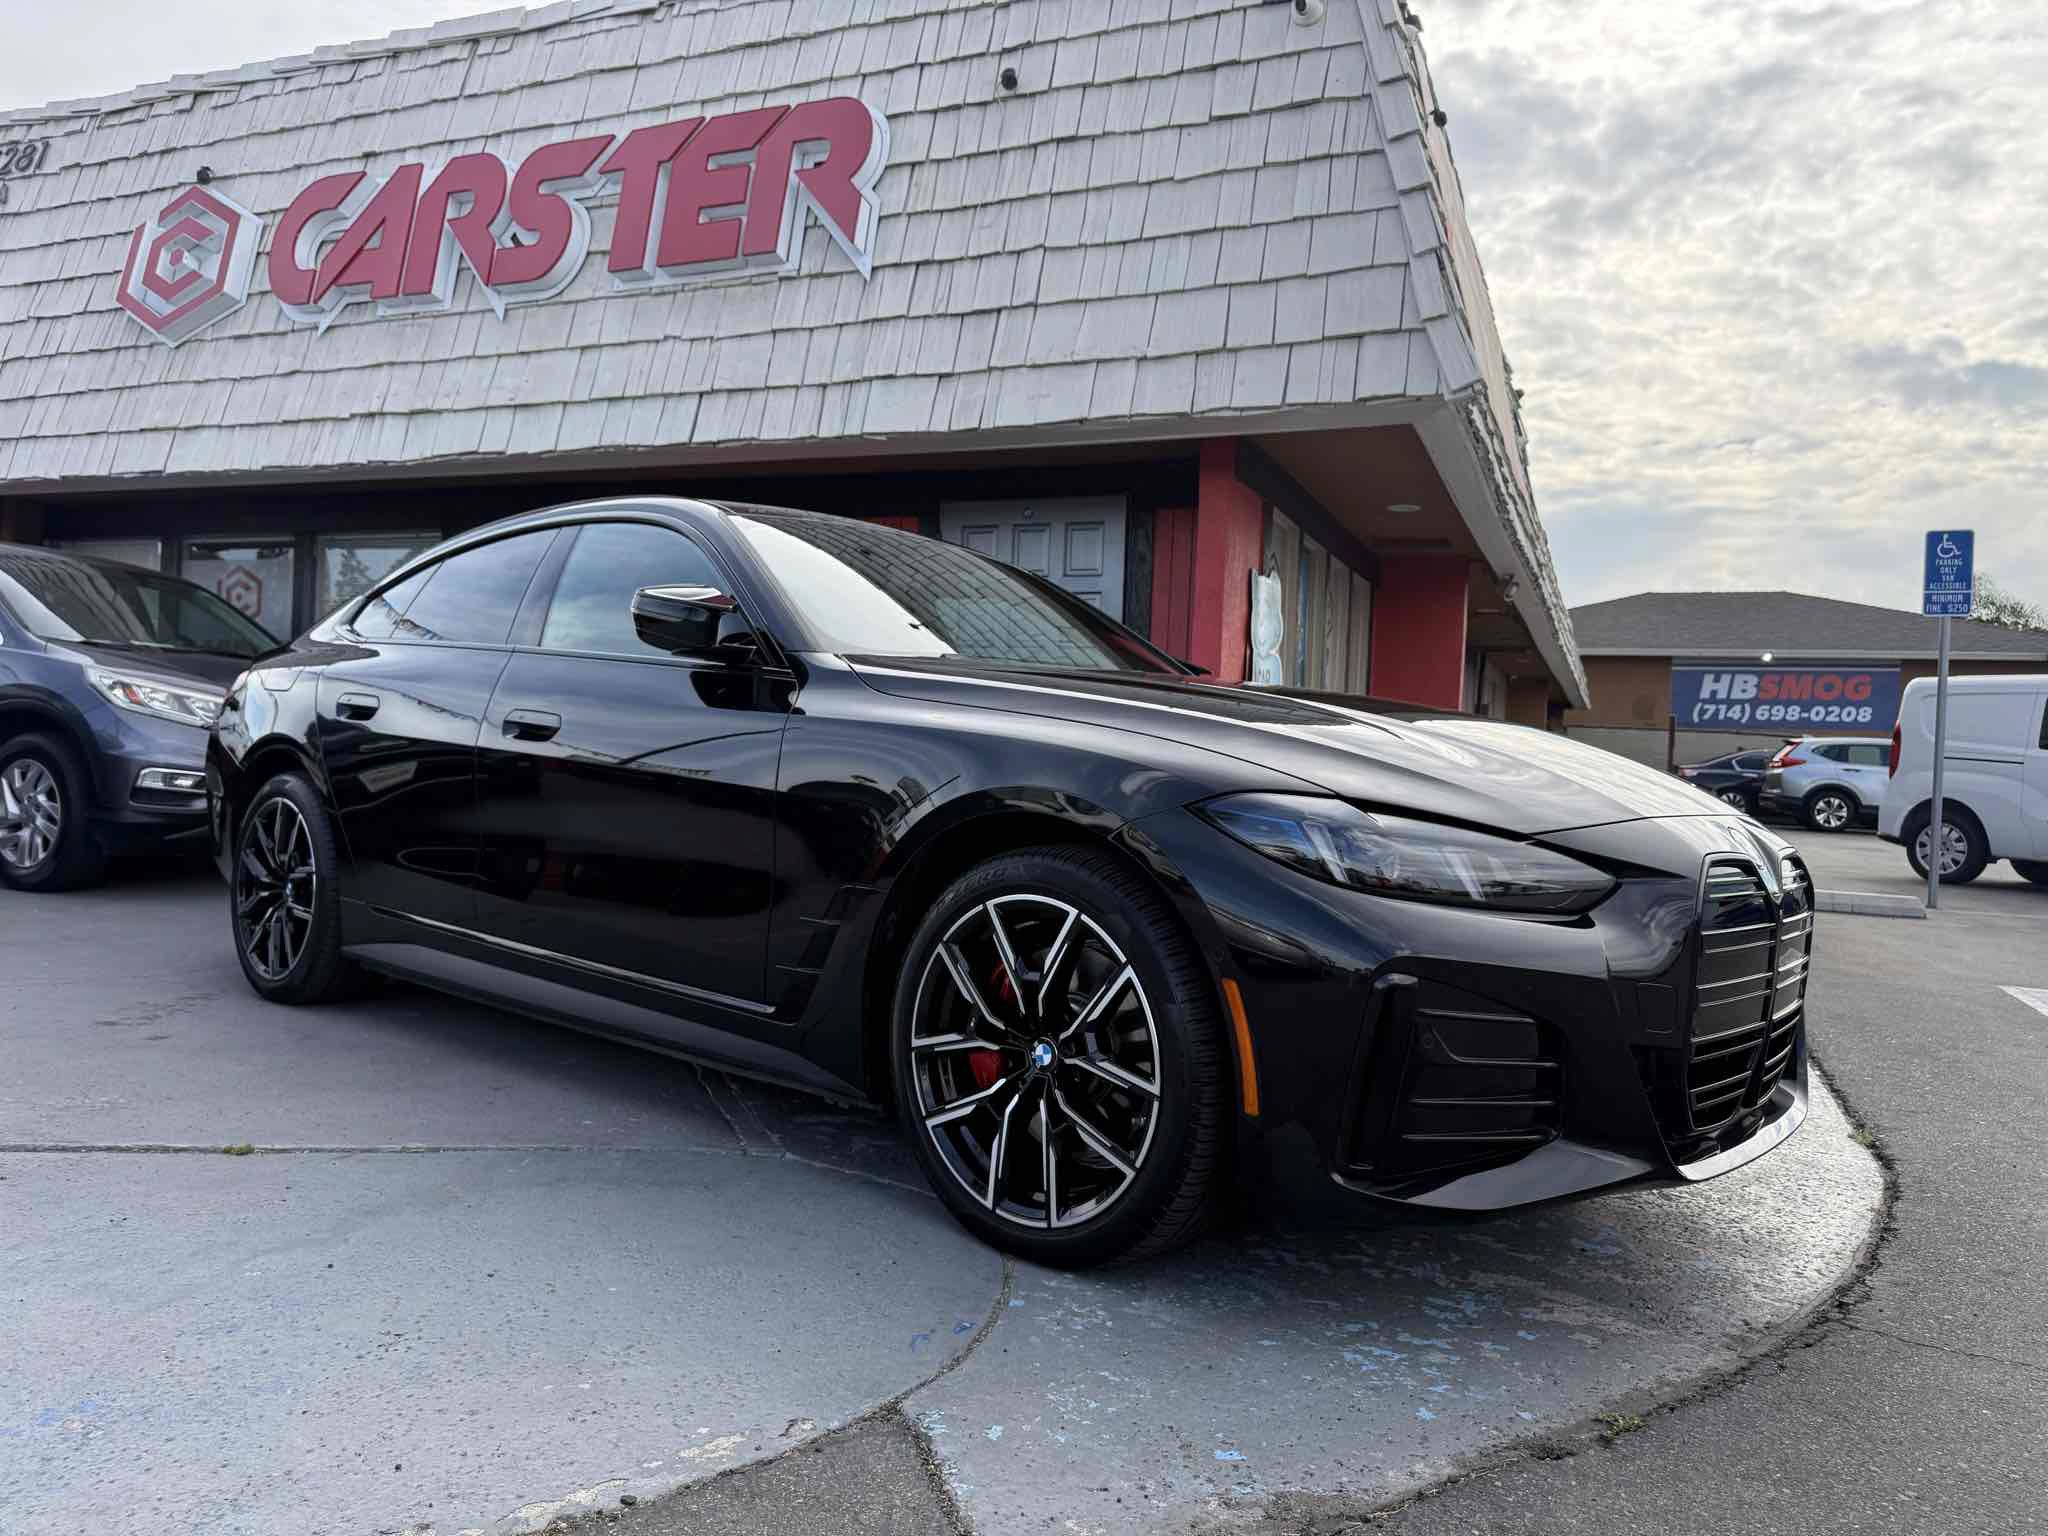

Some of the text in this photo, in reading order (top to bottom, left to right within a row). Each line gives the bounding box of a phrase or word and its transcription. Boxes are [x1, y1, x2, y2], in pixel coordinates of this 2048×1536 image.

[0, 140, 50, 176] 281
[267, 95, 887, 318] CARSTER
[1935, 558, 1963, 566] PARKING
[1939, 566, 1957, 574] ONLY
[1941, 574, 1955, 582] VAN
[1929, 581, 1967, 590] ACCESSIBLE
[1931, 594, 1964, 603] MINIMUM
[1926, 603, 1968, 613] FINE $250
[1692, 702, 1873, 724] (714) 698-0208
